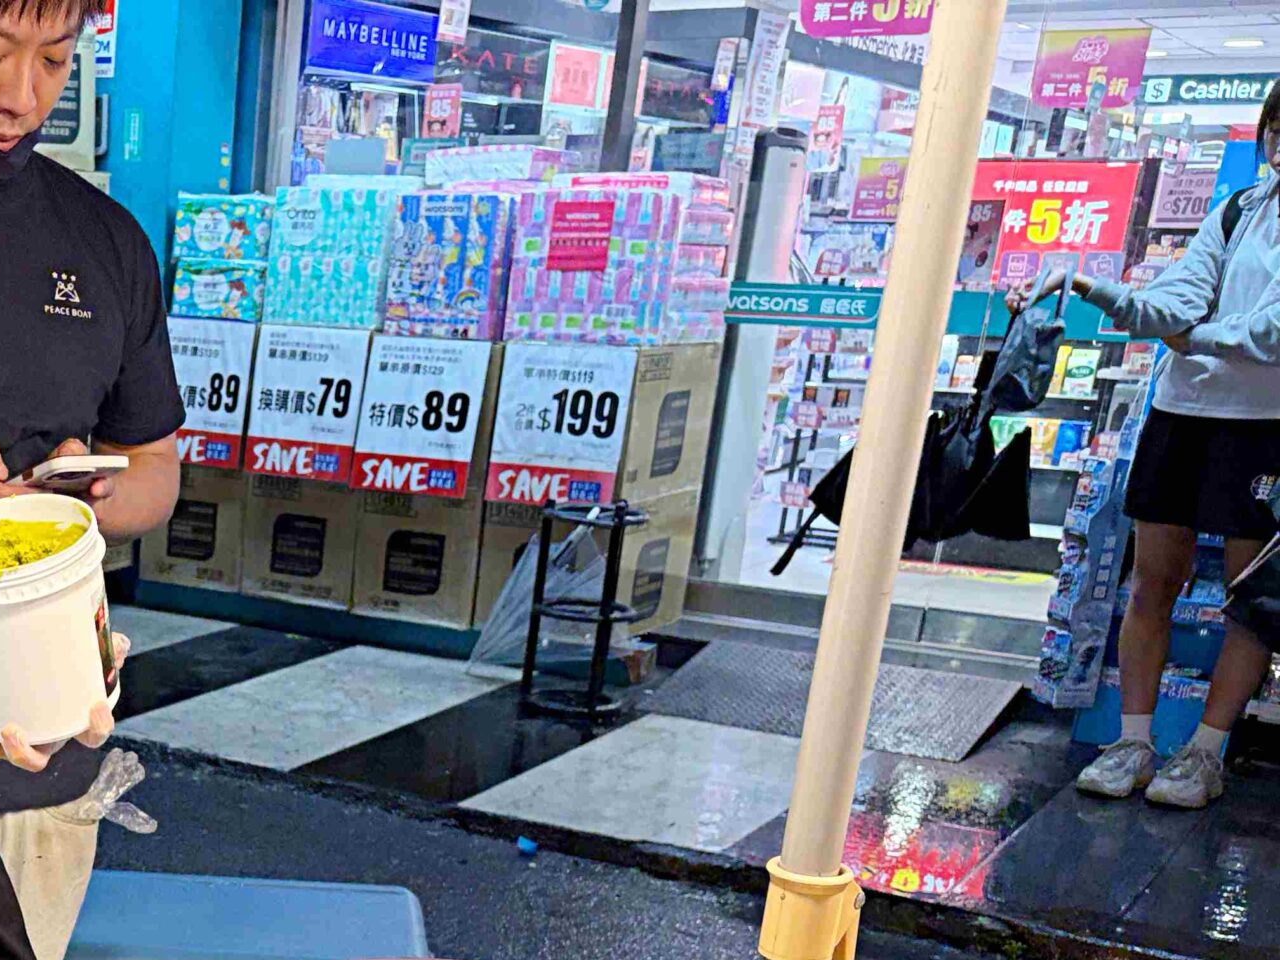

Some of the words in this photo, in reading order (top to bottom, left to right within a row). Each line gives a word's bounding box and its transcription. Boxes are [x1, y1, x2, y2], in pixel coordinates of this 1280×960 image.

[323, 18, 429, 54] MAYBELLINE
[390, 48, 405, 58] NEW
[407, 51, 427, 61] YORK
[451, 45, 540, 75] KATE
[1179, 80, 1262, 99] Cashier
[44, 304, 70, 316] PEACE
[71, 308, 92, 319] BOAT
[820, 297, 867, 316] 屈臣氏
[252, 441, 314, 475] SAVE
[361, 457, 430, 492] SAVE
[498, 469, 570, 504] SAVE
